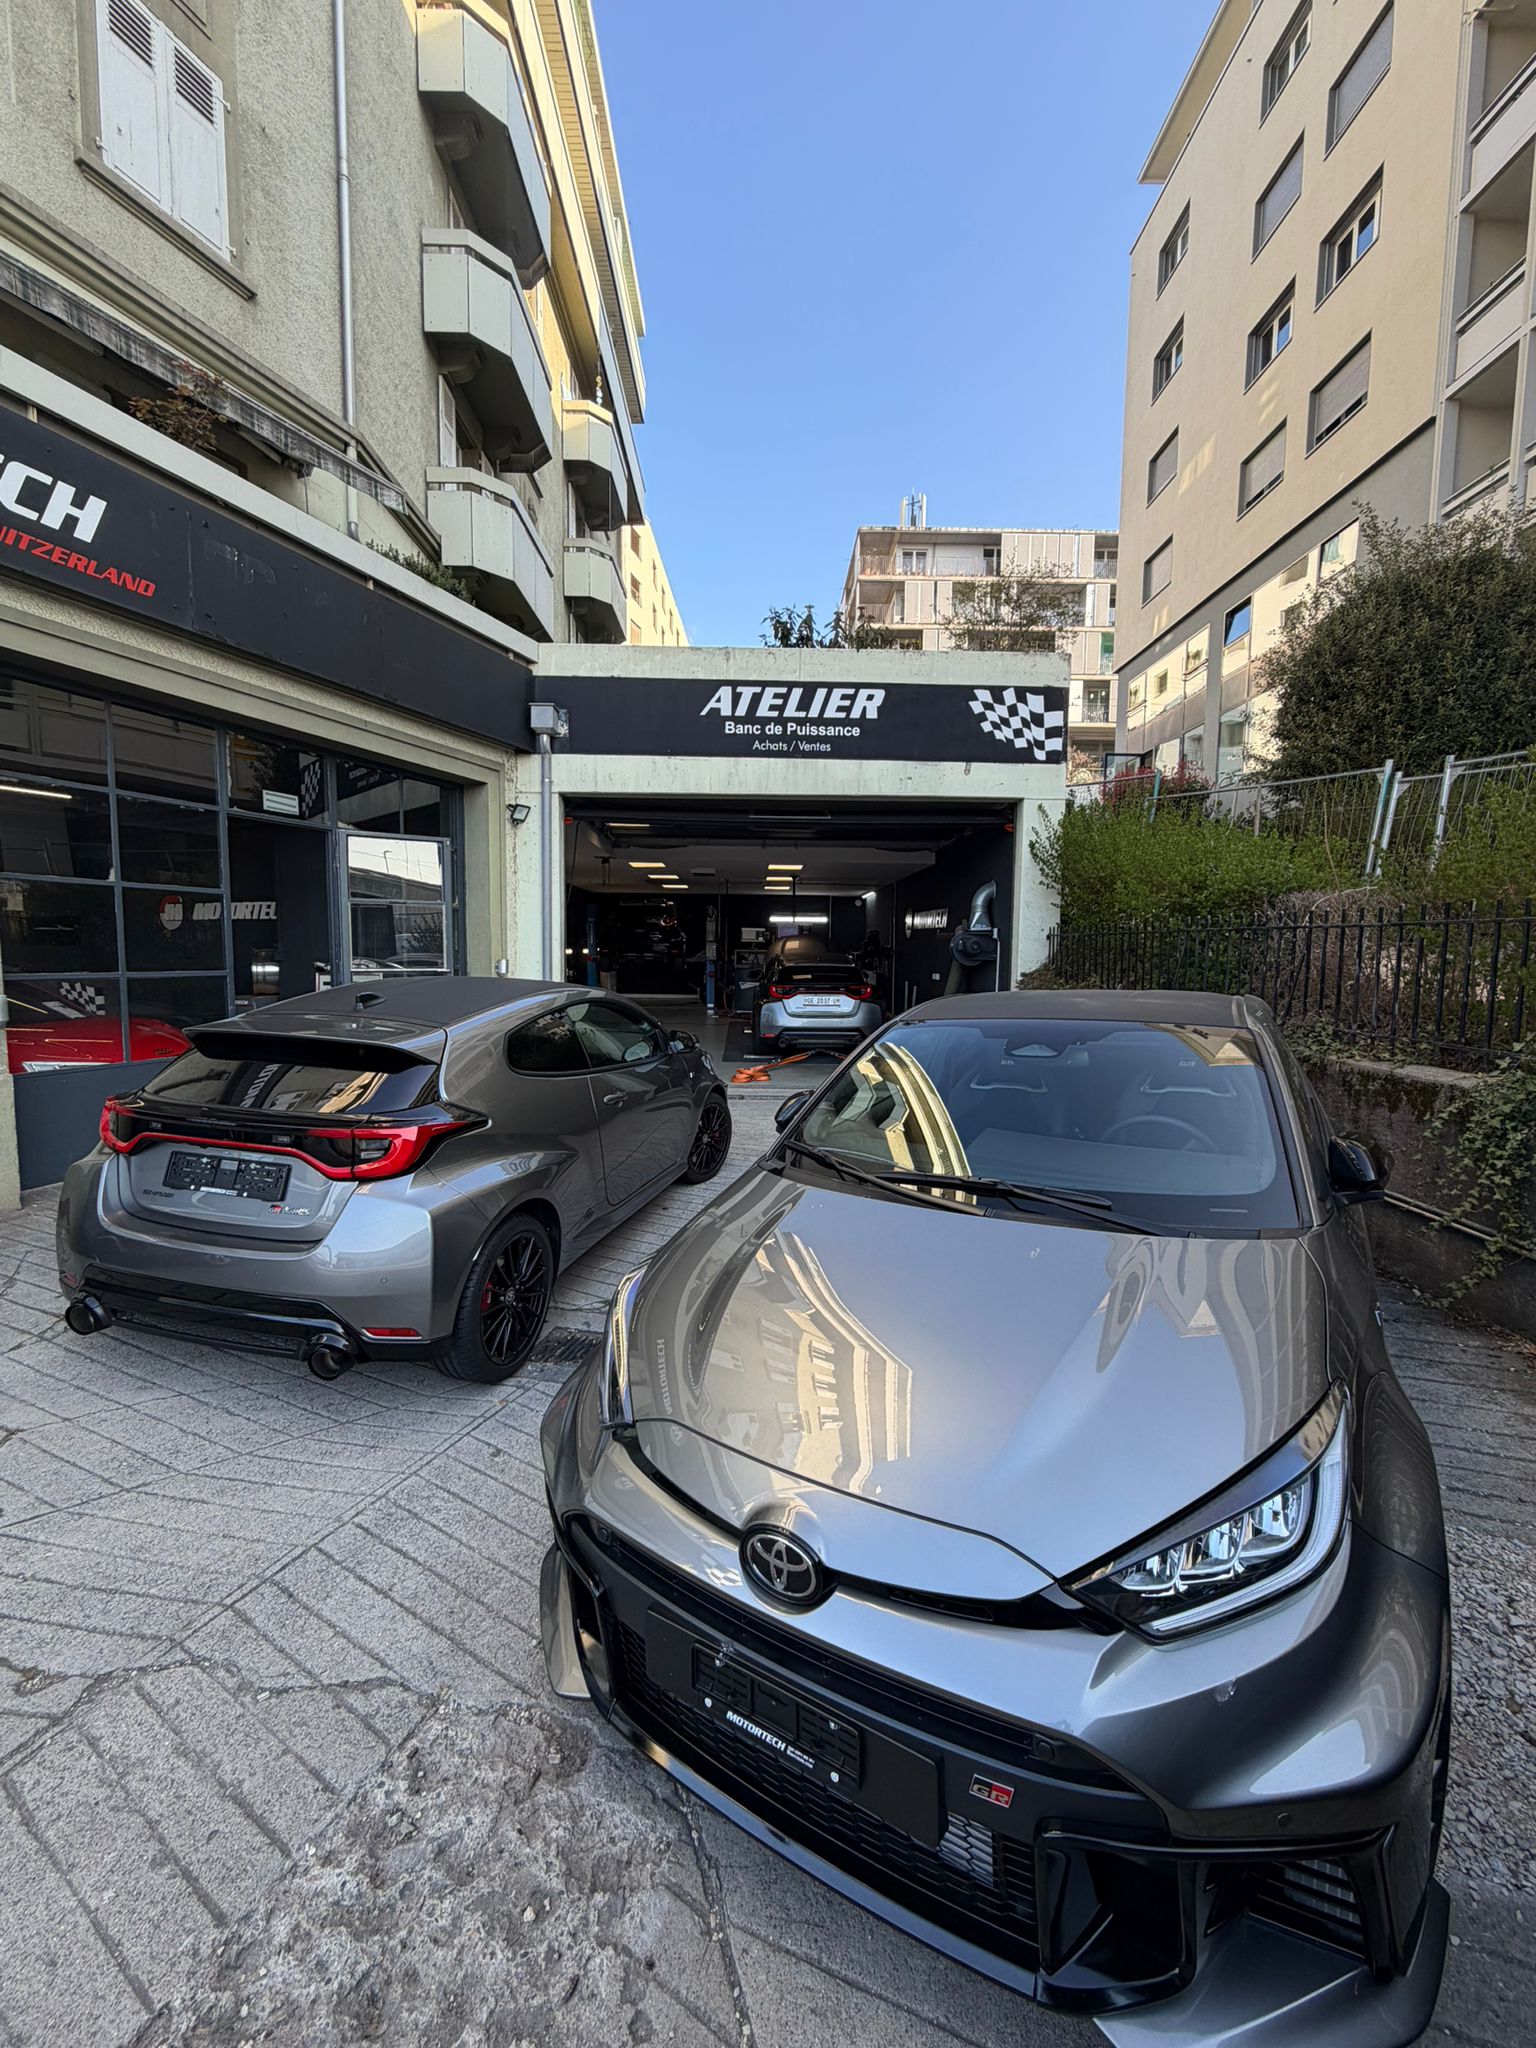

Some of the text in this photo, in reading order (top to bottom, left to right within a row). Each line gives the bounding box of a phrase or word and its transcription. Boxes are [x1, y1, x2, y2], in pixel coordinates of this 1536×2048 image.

[0, 454, 107, 543] CH
[0, 526, 156, 597] ITZERLAND
[700, 685, 885, 719] ATELIER
[725, 721, 860, 737] Banc de Puissance
[753, 740, 787, 751] Achats
[798, 740, 831, 752] Ventes
[726, 1710, 787, 1752] MOTORTECH
[972, 1783, 1009, 1804] GR
